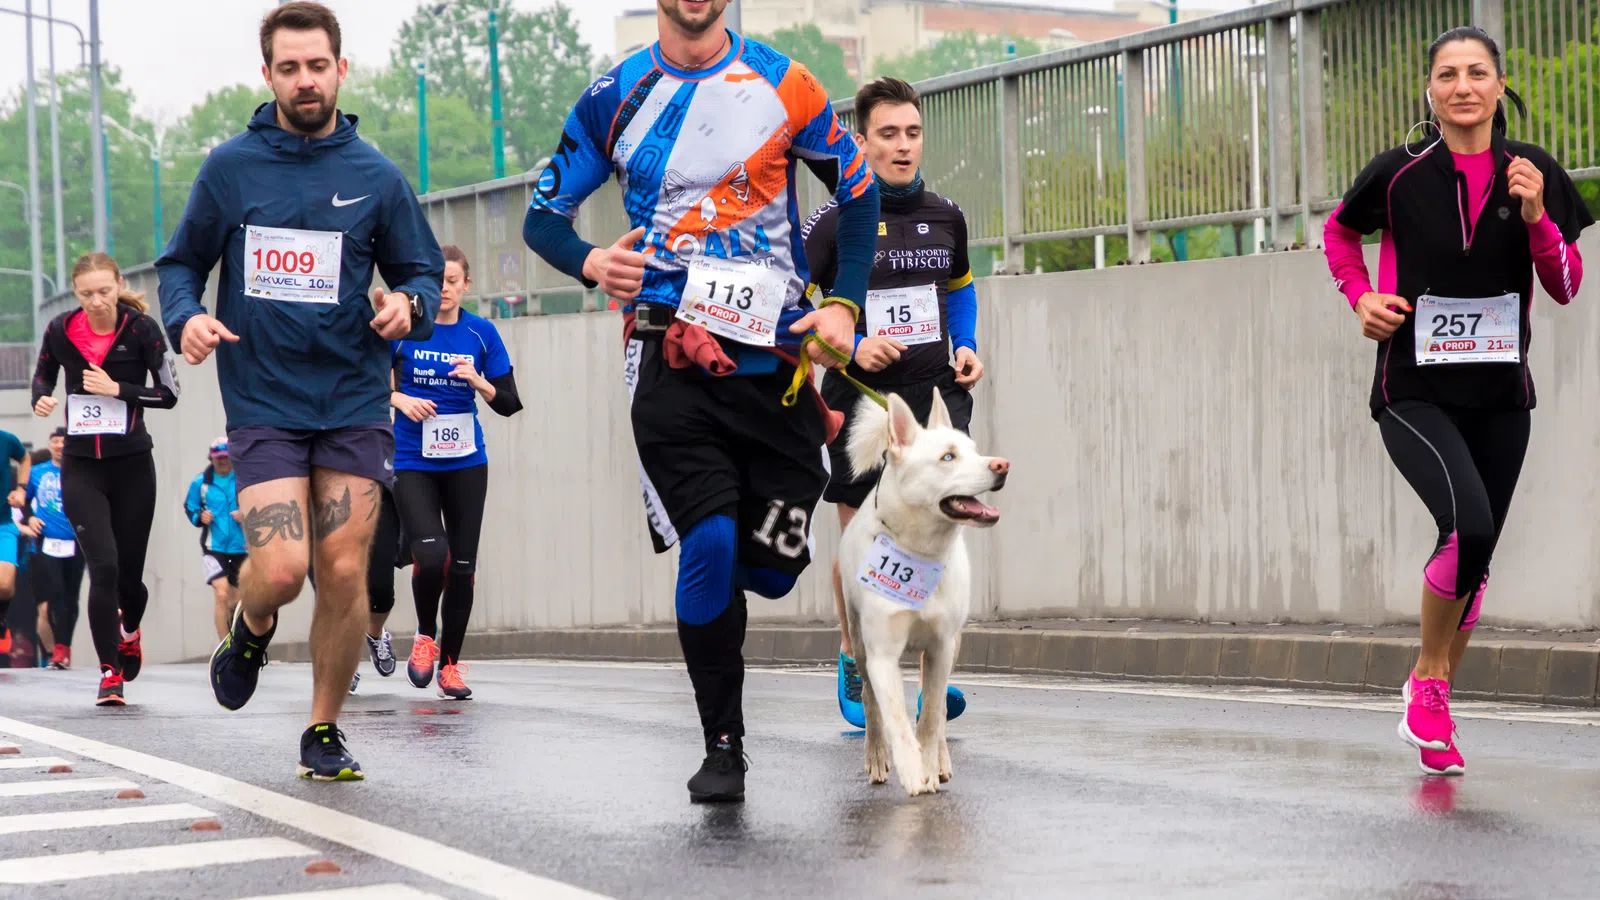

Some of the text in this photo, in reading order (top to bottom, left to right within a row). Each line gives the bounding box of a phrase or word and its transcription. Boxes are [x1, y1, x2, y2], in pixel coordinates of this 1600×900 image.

[651, 225, 772, 261] KOALA
[888, 249, 913, 258] CLUB
[252, 248, 315, 274] 1009
[888, 256, 950, 270] TIBISCUS
[255, 274, 302, 287] AKWEL
[706, 280, 754, 310] 113
[710, 306, 738, 323] PROFI
[886, 305, 912, 324] 15
[889, 326, 911, 334] PROFI
[1431, 312, 1483, 337] 257
[1445, 342, 1473, 350] PROFI
[414, 349, 440, 361] NTT
[429, 378, 448, 386] DATA
[450, 379, 468, 388] Team
[82, 405, 102, 418] 33
[432, 427, 459, 441] 186
[752, 499, 808, 559] 13
[880, 555, 914, 582] 113
[879, 576, 900, 589] PROFI
